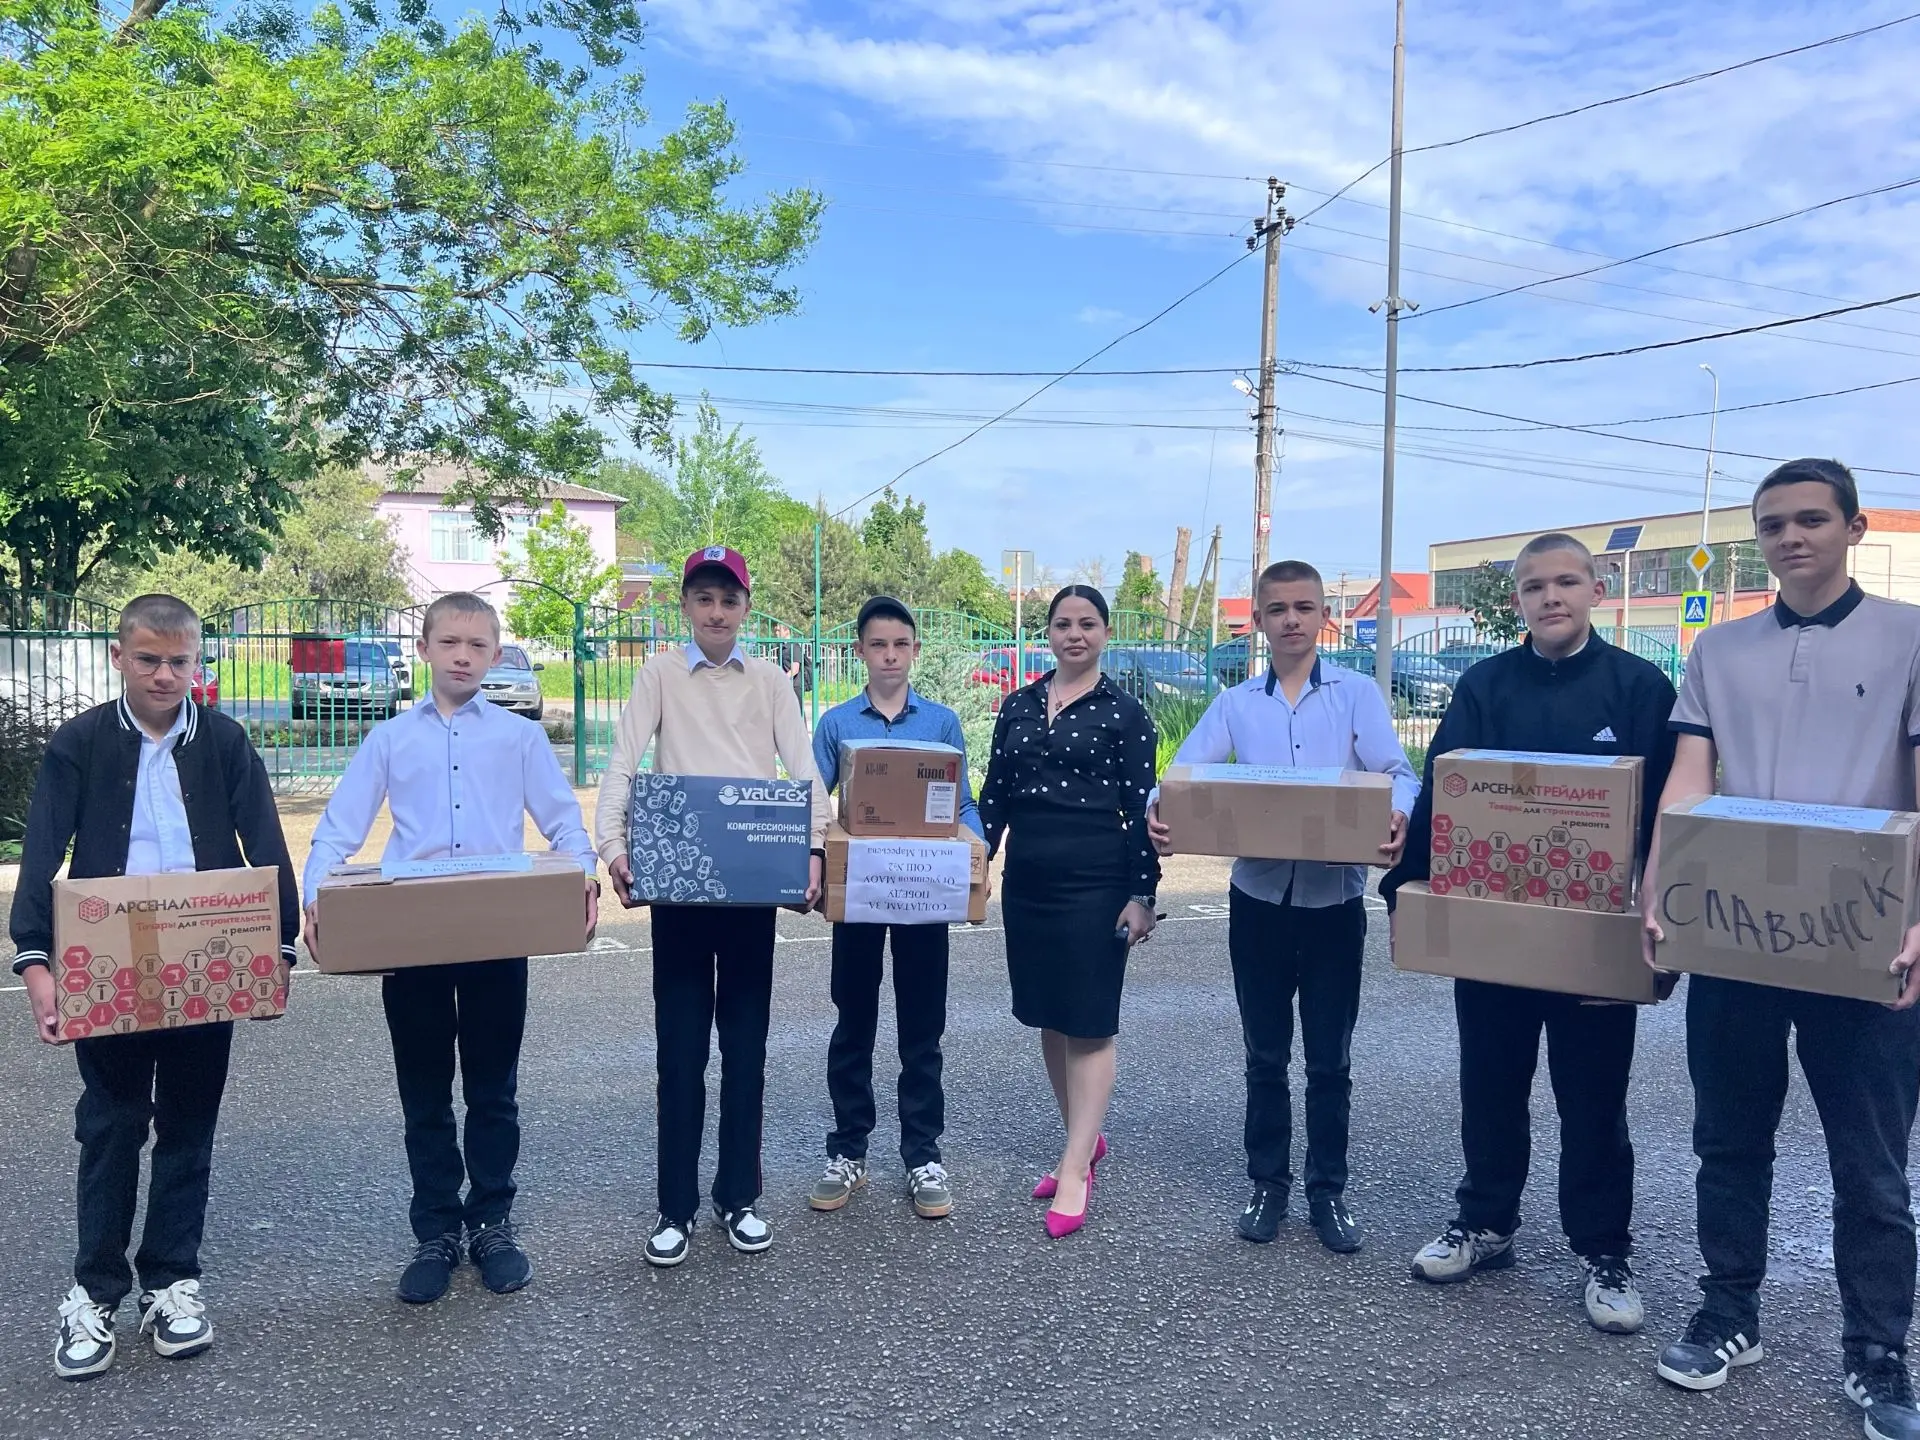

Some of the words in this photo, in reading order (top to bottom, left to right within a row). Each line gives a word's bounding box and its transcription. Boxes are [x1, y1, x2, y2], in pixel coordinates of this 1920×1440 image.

[1488, 801, 1522, 813] Товары
[1523, 807, 1540, 815] для
[1543, 807, 1611, 819] строительства
[727, 822, 806, 833] КОМПРЕССИОННЫЕ
[1569, 820, 1610, 830] ремонта
[746, 834, 787, 844] ФИТИНГИ
[788, 835, 806, 845] ПНД
[867, 846, 915, 857] Маресьева
[906, 863, 932, 872] СОШ
[863, 875, 896, 884] МАОУ
[898, 875, 941, 884] учеников
[943, 877, 955, 885] От
[887, 889, 930, 899] ПОБЕДУ
[178, 920, 197, 930] для
[199, 914, 272, 927] строительства
[230, 925, 272, 936] ремонта
